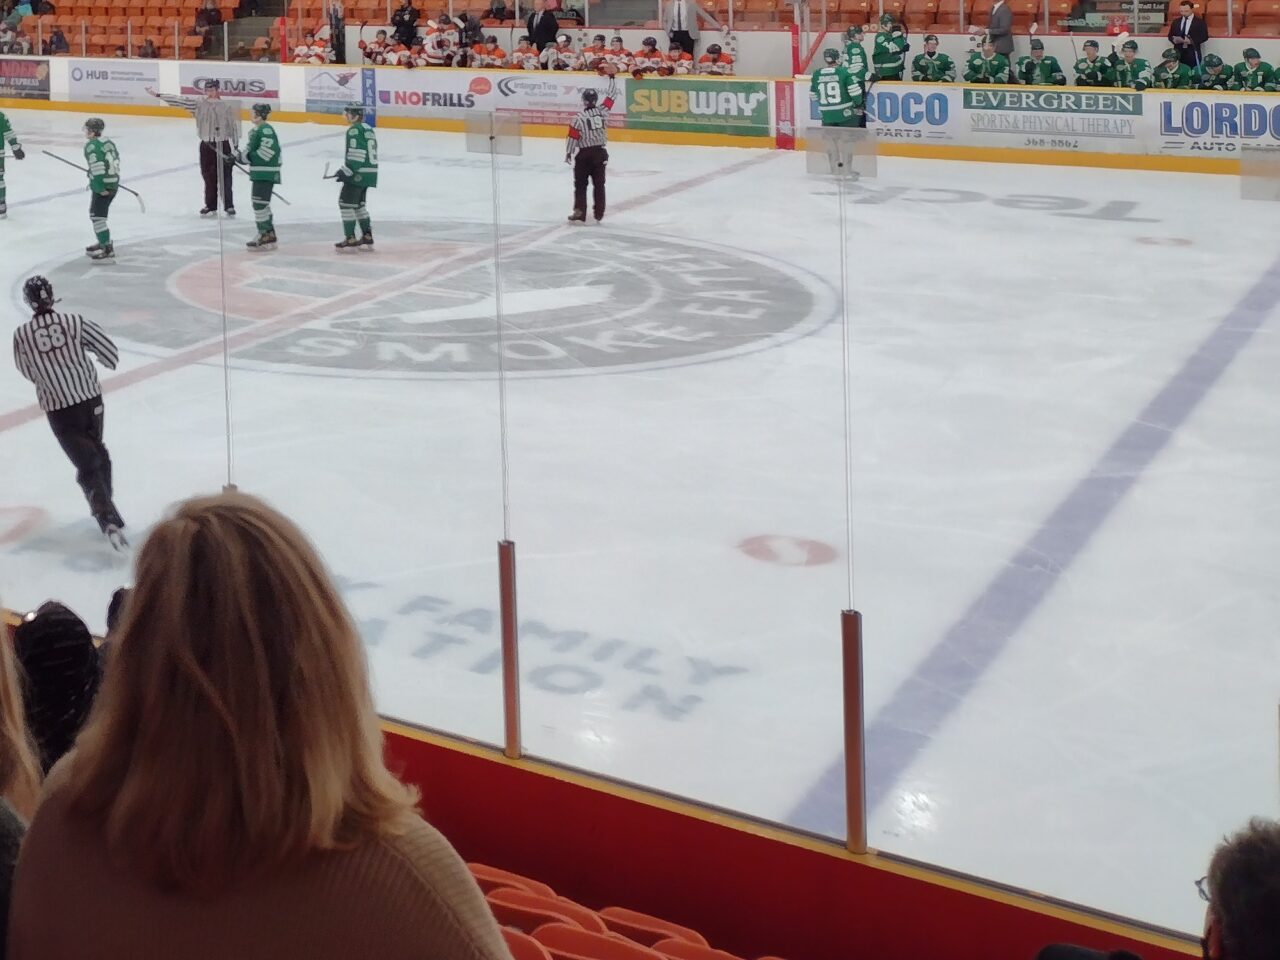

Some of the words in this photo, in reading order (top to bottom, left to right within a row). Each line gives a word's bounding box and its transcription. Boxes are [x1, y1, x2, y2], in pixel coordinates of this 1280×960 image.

[86, 70, 108, 80] HUB
[394, 91, 475, 108] NOFRILLS
[628, 89, 767, 116] SUBWAY
[818, 81, 841, 104] 19
[970, 90, 1135, 111] EVERGREEN
[587, 115, 602, 130] 19
[971, 113, 1009, 129] SPORTS
[1010, 118, 1019, 129] &
[1022, 114, 1076, 132] PHYSICAL
[1080, 117, 1135, 134] THERAPY
[1190, 141, 1236, 151] AUTO
[34, 324, 66, 352] 68
